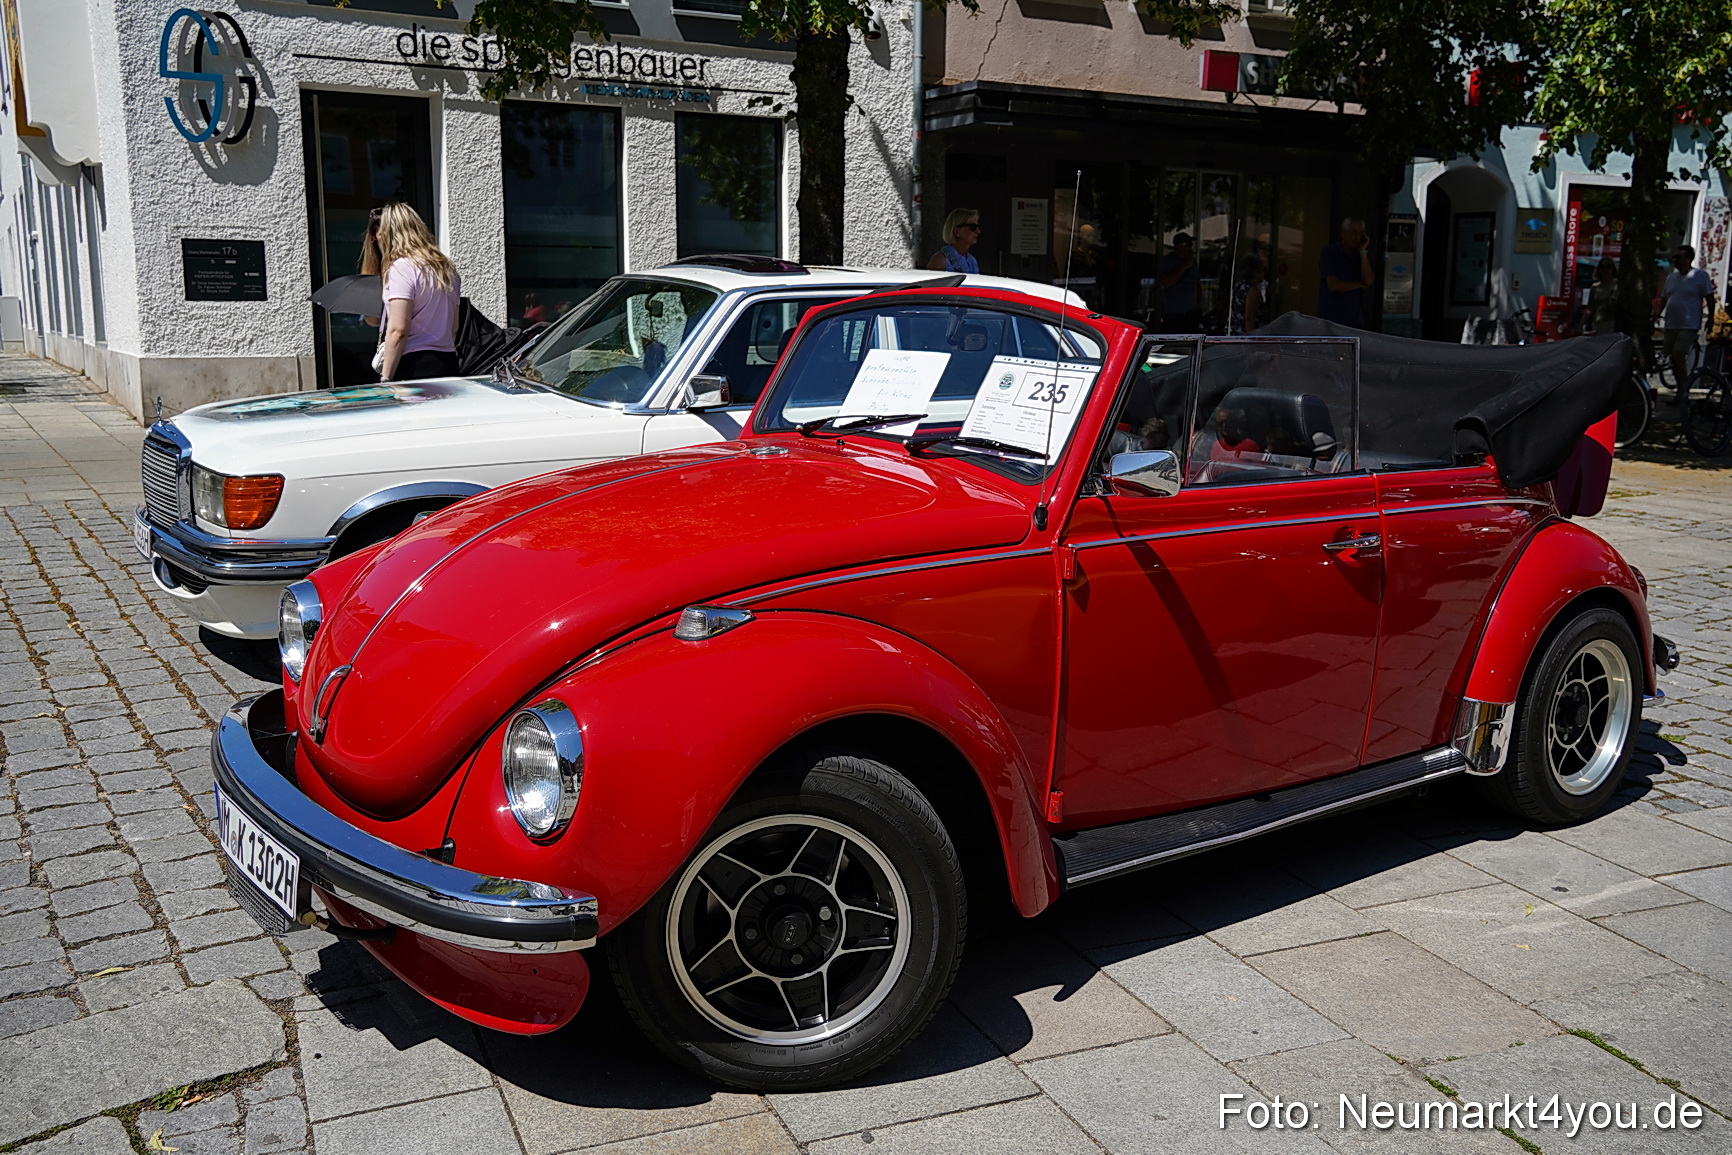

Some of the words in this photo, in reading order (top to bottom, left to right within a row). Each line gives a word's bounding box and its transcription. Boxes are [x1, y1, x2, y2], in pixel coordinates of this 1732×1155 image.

[396, 22, 451, 61] die
[461, 36, 711, 81] spgenbauer
[1566, 207, 1578, 244] Store
[1027, 381, 1070, 404] 235
[247, 830, 295, 910] 1302H
